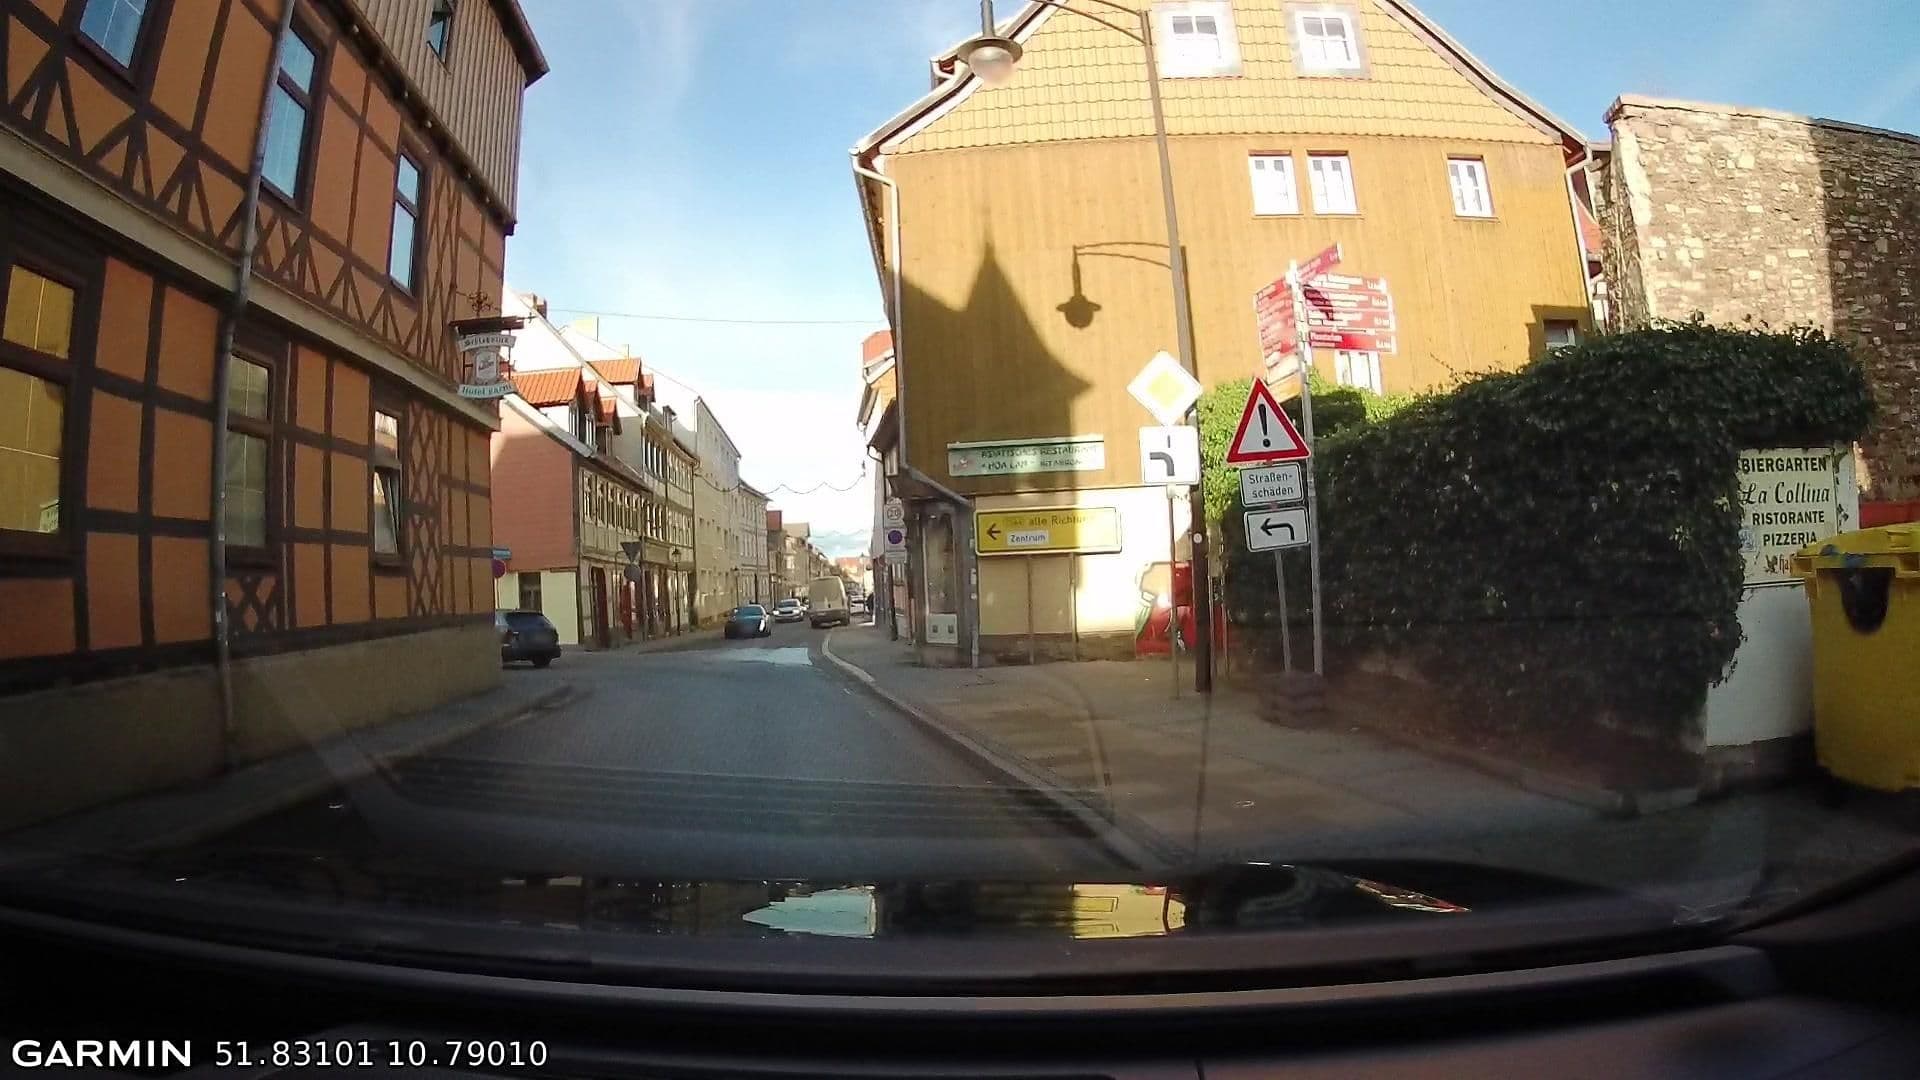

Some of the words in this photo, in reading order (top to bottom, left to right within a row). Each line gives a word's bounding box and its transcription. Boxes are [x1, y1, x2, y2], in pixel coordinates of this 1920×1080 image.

[1741, 457, 1827, 473] BIERGARTEN
[1248, 472, 1293, 484] Straßen-
[1252, 486, 1294, 499] schäden
[1741, 482, 1767, 504] La
[1774, 481, 1830, 503] Collina
[1752, 511, 1825, 525] RISTORANTE
[1010, 533, 1046, 543] Zentrum
[1763, 531, 1817, 546] PIZZERIA
